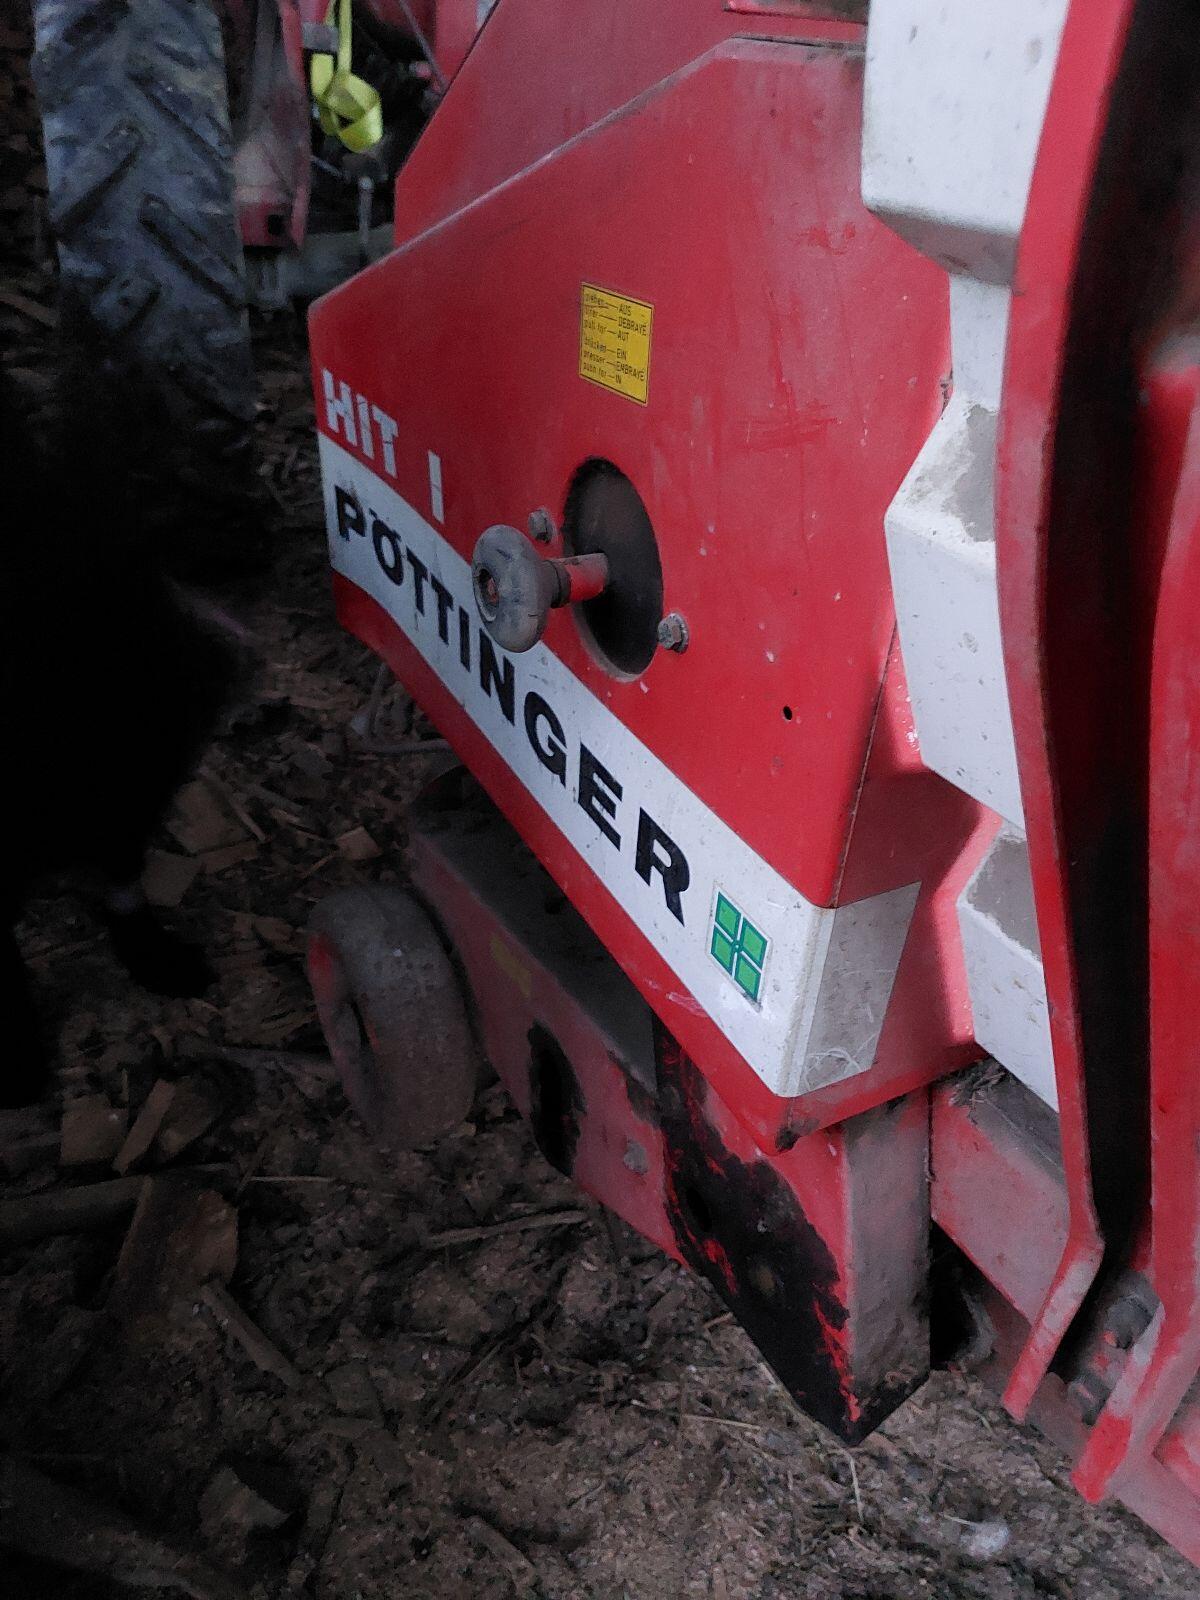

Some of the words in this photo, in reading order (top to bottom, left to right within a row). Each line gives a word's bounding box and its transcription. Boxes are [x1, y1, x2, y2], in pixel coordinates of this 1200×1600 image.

[619, 303, 632, 316] AUS
[616, 348, 627, 361] EIN
[615, 374, 622, 384] IN
[322, 368, 399, 479] HIT
[334, 484, 691, 927] PÖTTINGER
